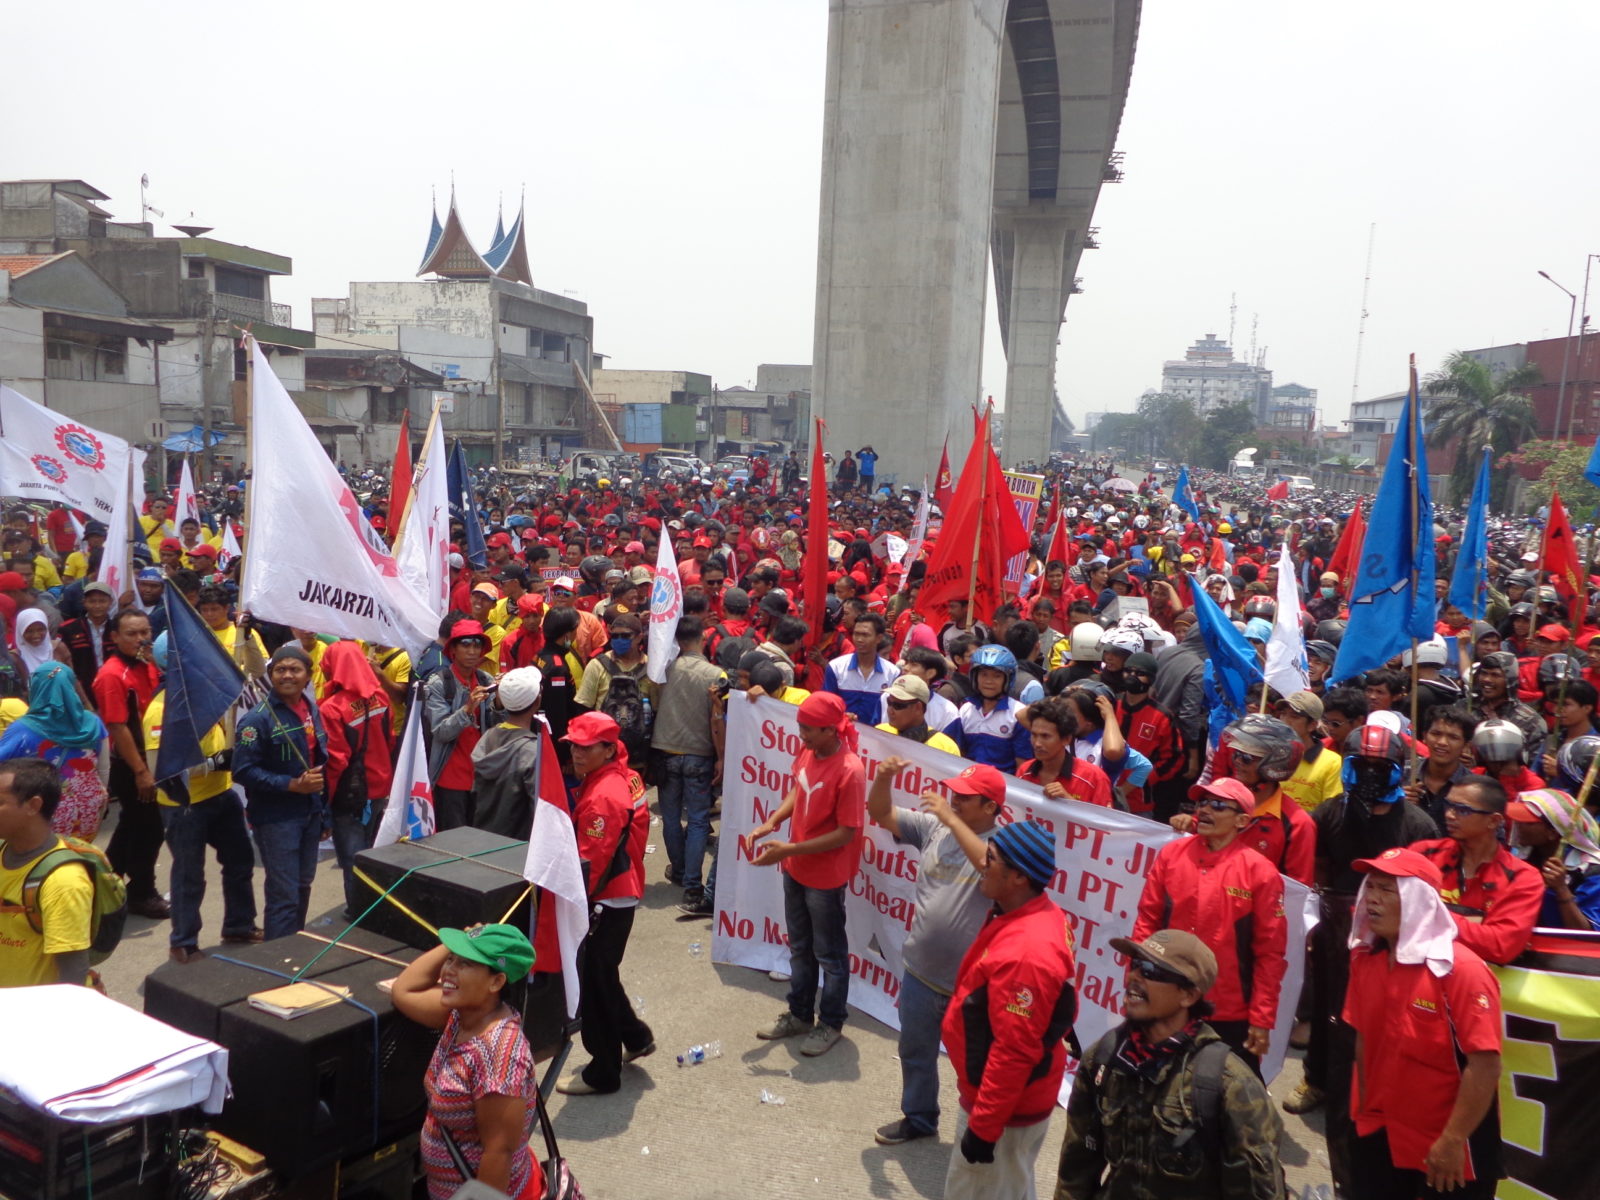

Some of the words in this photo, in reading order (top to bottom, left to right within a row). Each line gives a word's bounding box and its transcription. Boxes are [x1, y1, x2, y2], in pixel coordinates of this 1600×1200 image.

[299, 580, 374, 618] JAKARTA
[741, 755, 797, 800] Stop
[1077, 870, 1128, 919] PT.
[760, 720, 800, 757] Sto
[1065, 821, 1113, 865] PT.
[1125, 842, 1157, 878] JI
[862, 836, 918, 883] Outs
[718, 910, 754, 940] No
[848, 952, 902, 1008] orru
